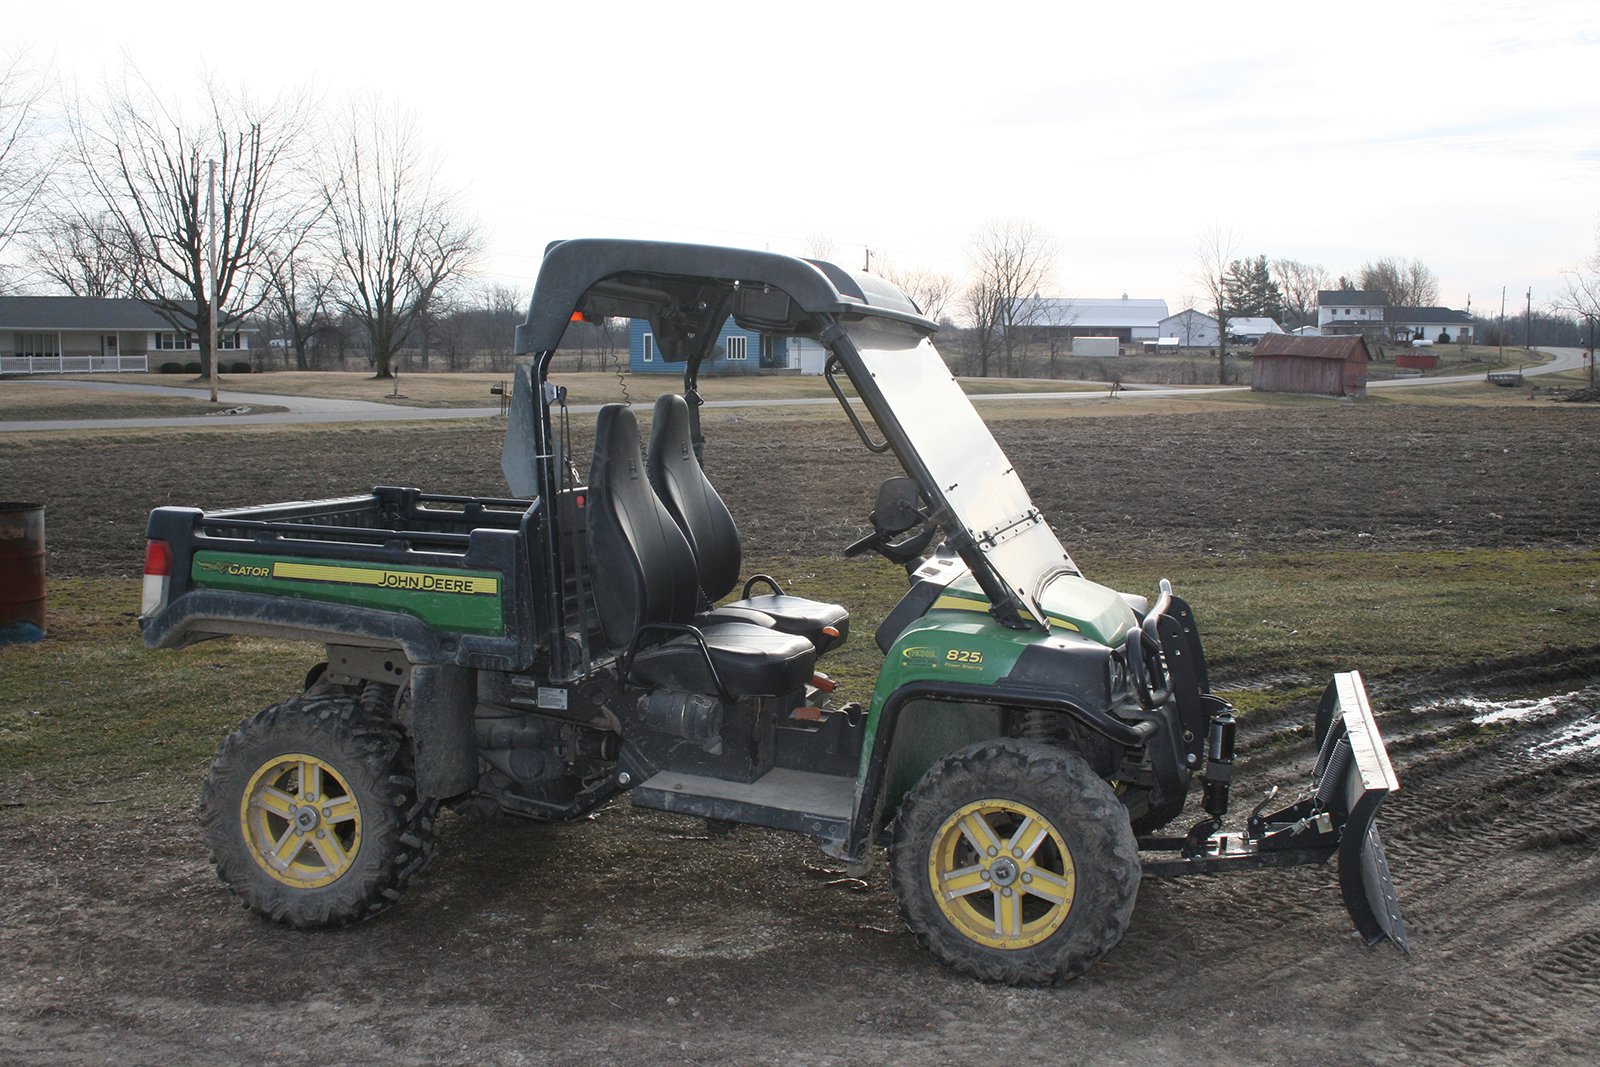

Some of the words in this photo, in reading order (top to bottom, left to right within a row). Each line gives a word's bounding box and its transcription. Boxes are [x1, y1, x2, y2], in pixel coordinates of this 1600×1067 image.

[228, 563, 270, 577] GATOR
[378, 572, 419, 588] JOHN
[423, 575, 474, 592] DEERE
[946, 649, 984, 664] 825i
